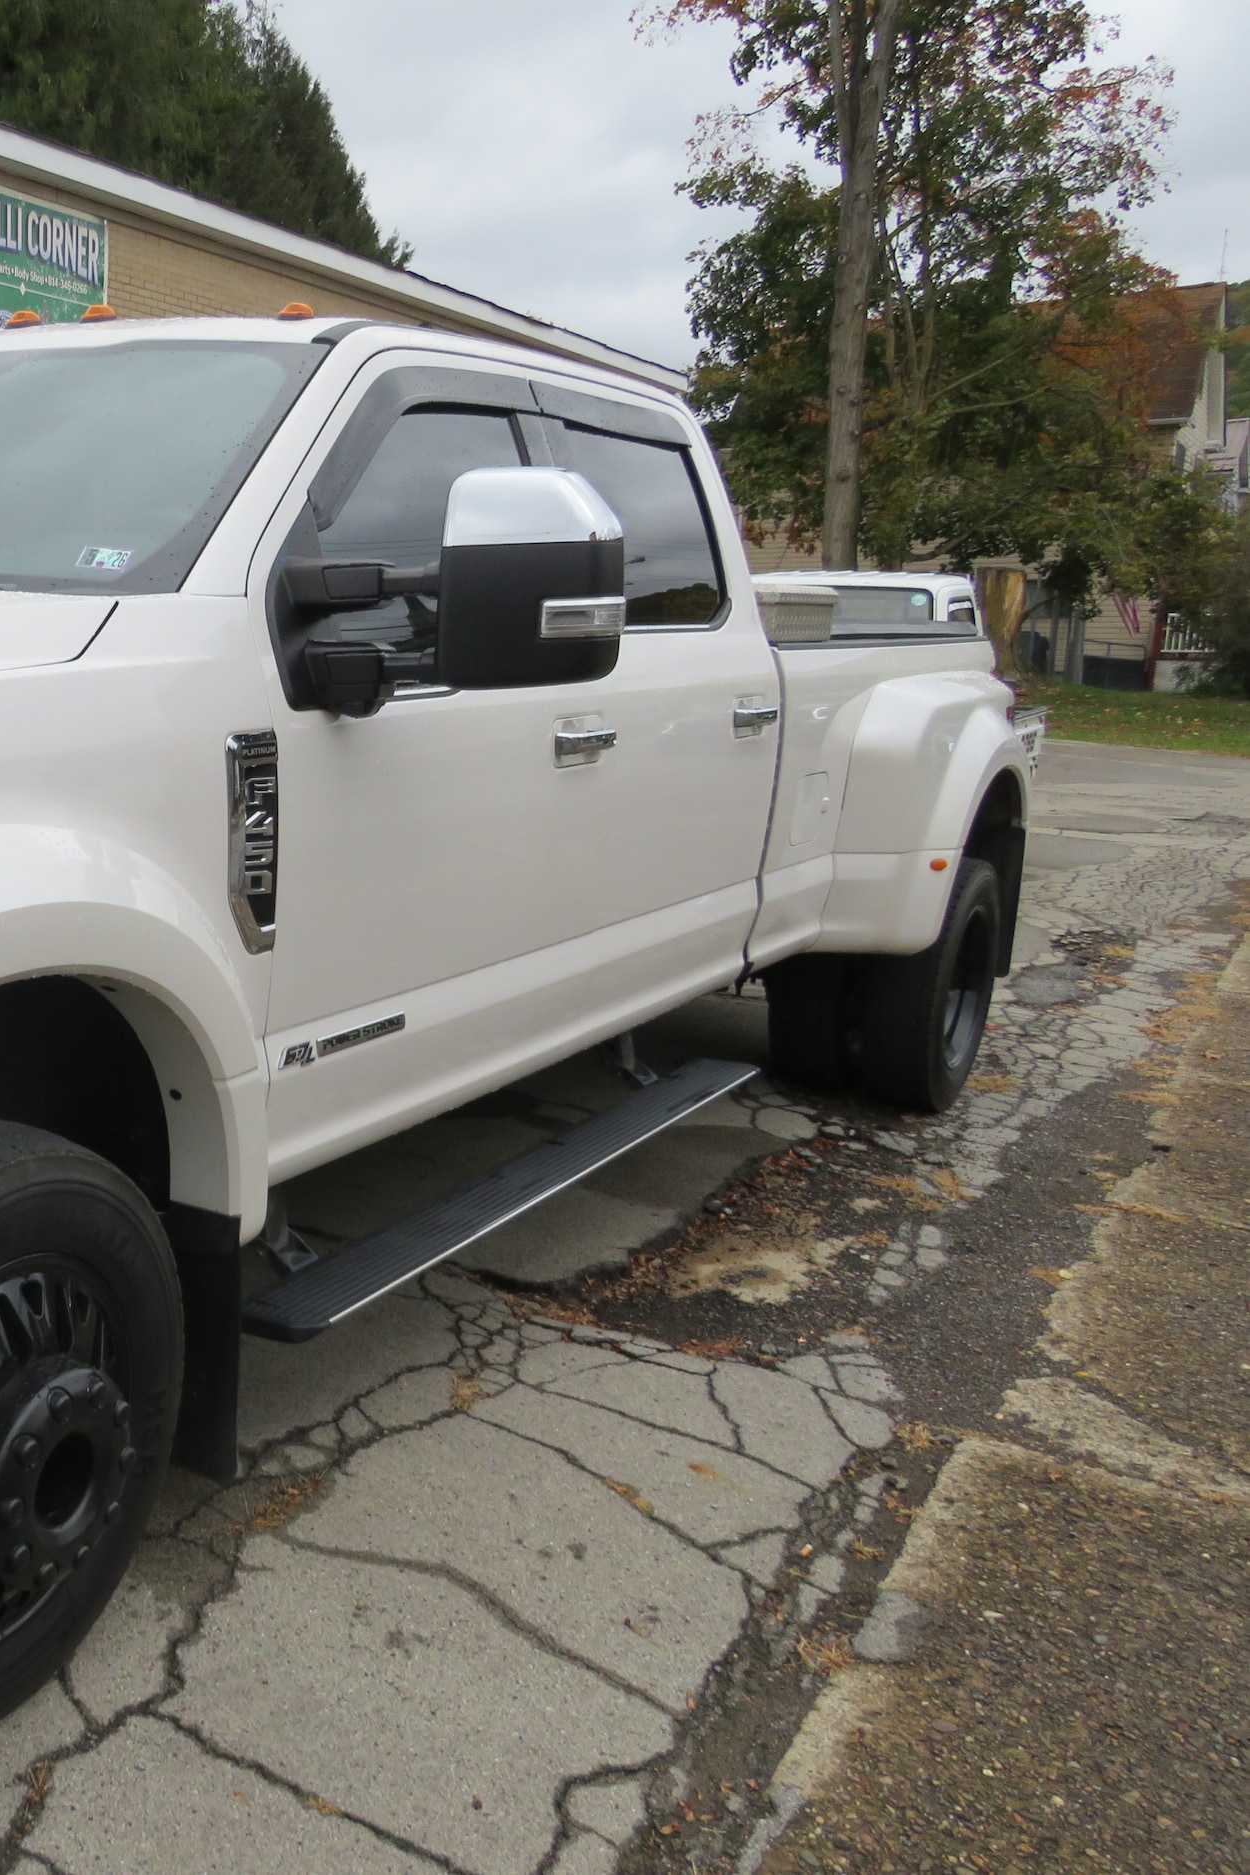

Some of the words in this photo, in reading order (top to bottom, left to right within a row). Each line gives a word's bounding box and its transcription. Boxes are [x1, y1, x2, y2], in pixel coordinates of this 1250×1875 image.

[27, 211, 99, 287] CORNER
[14, 267, 30, 281] Body
[30, 271, 45, 286] Shop
[111, 551, 129, 568] 26
[242, 744, 277, 757] PLATINUM
[322, 1031, 361, 1050] POWER
[362, 1015, 406, 1037] STROKE
